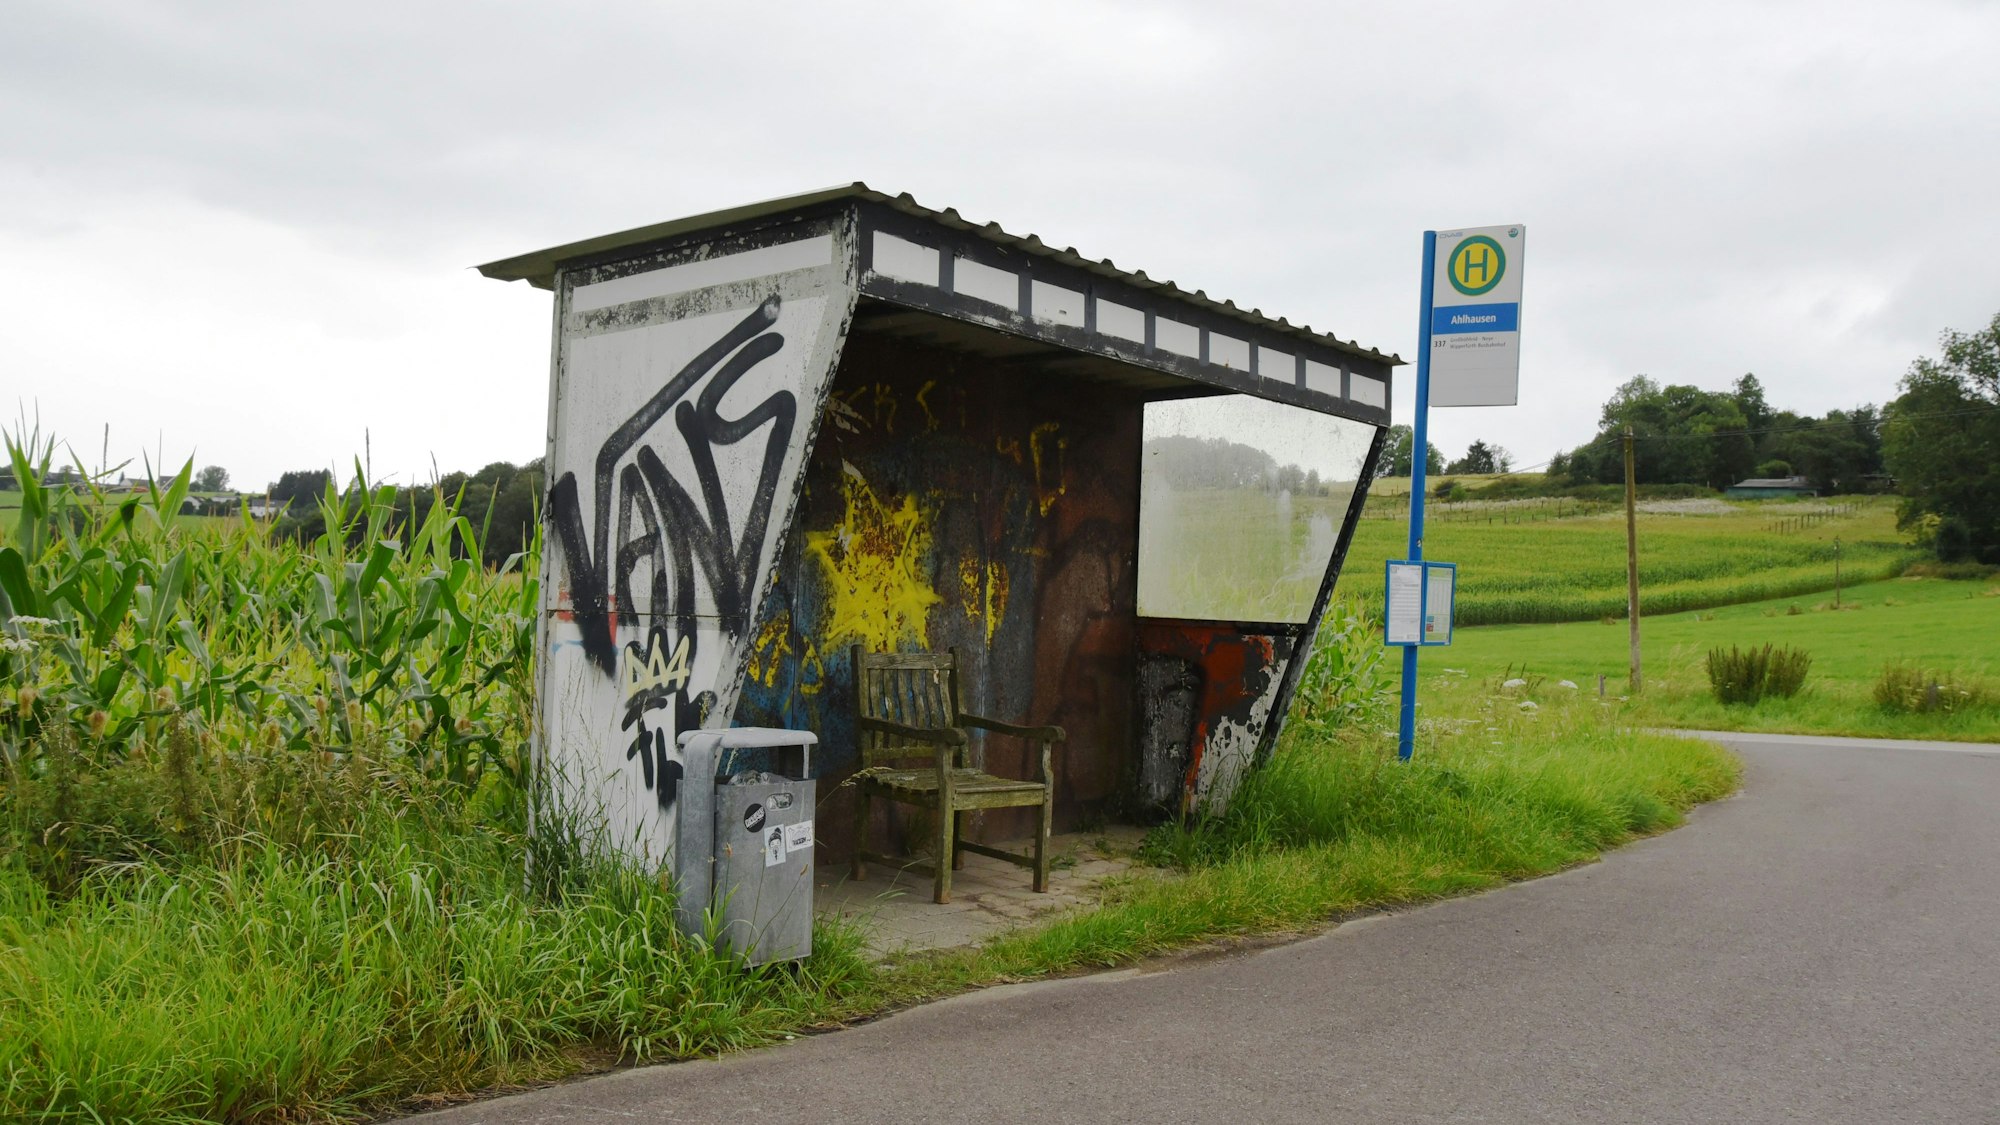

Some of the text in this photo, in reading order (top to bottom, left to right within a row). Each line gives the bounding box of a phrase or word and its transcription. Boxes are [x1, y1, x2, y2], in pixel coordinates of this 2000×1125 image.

[1464, 248, 1488, 283] H
[1450, 314, 1497, 325] Ahlhausen
[1433, 340, 1446, 348] 337
